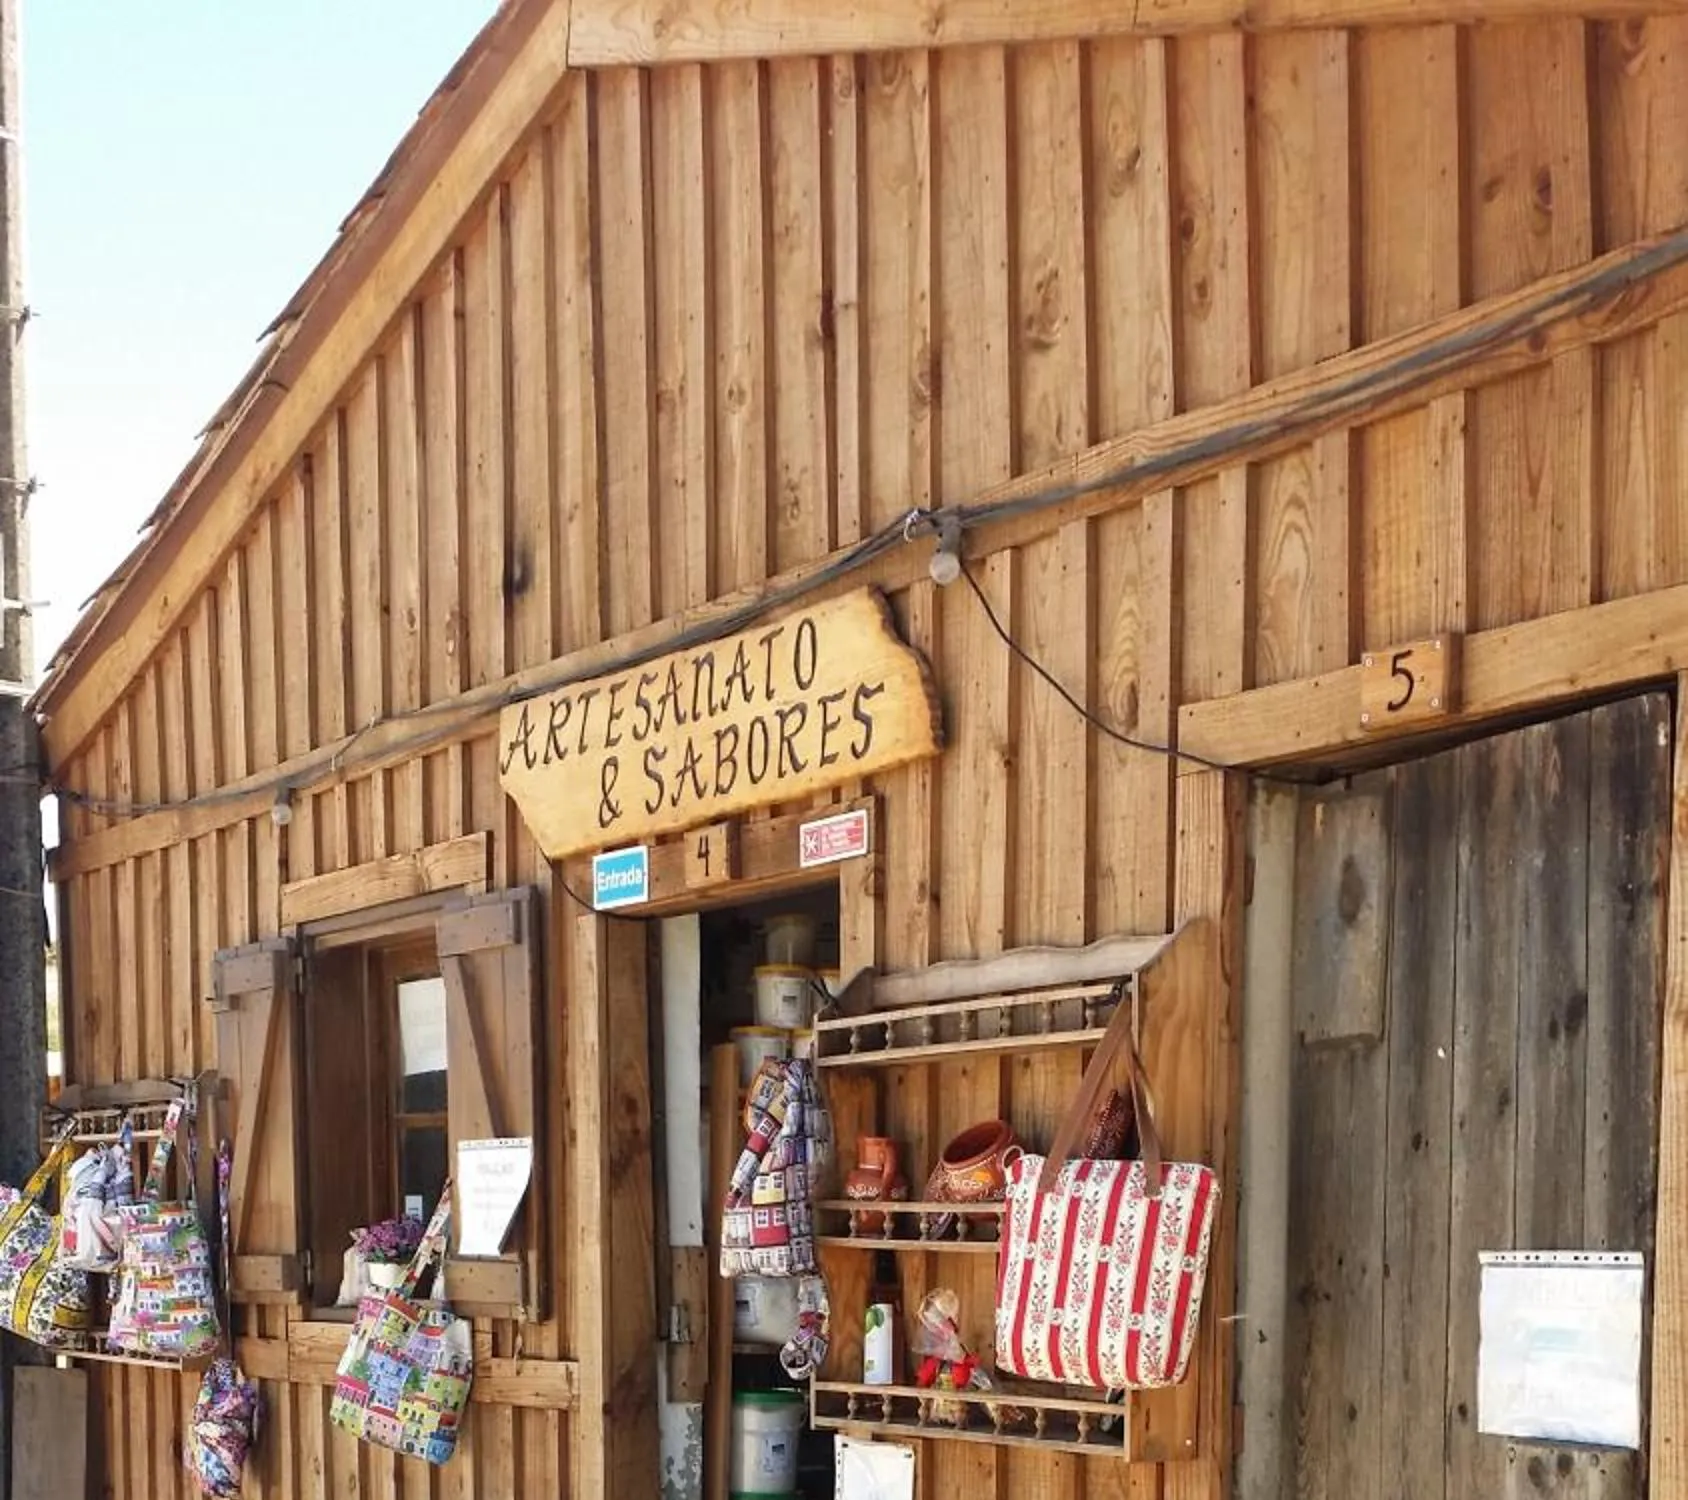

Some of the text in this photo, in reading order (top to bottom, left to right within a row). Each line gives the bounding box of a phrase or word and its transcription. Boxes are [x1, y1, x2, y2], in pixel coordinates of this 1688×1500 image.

[500, 617, 817, 776] ARTESANATO
[1387, 649, 1415, 711] 5
[597, 681, 886, 828] & SABORES
[597, 865, 642, 891] Entrada
[697, 835, 710, 876] 4
